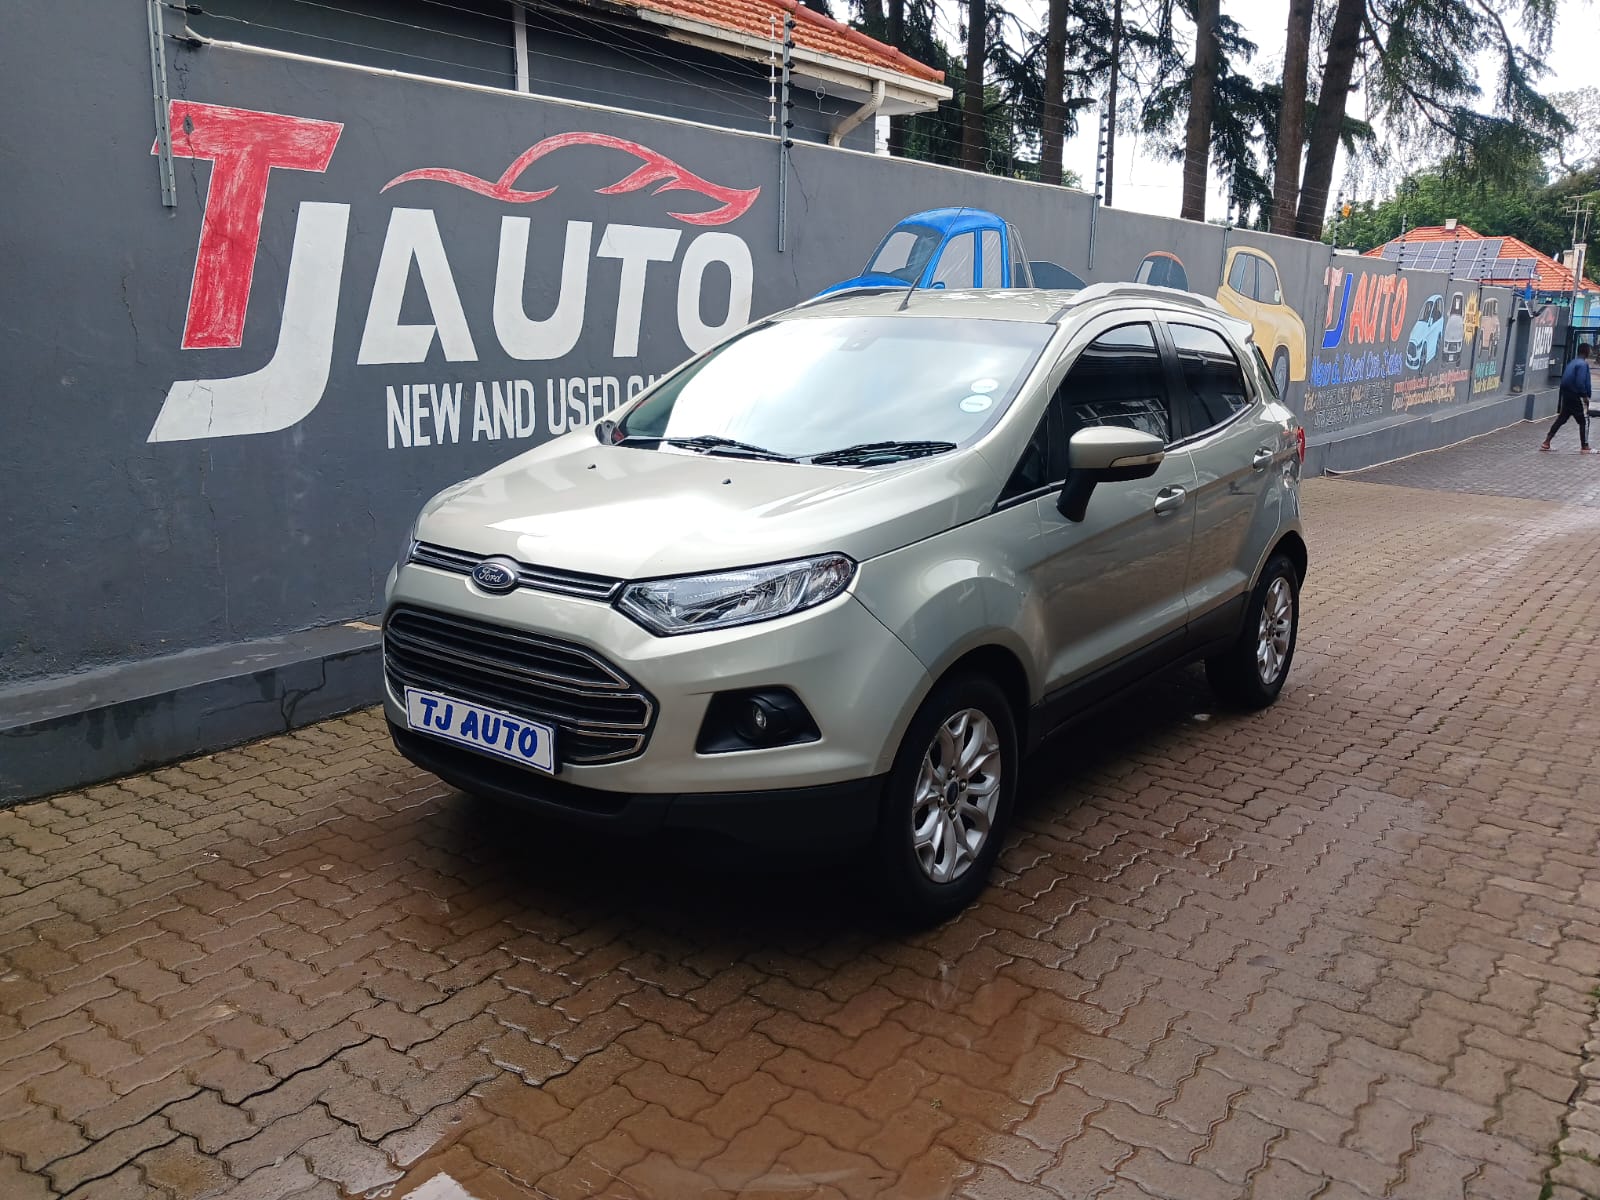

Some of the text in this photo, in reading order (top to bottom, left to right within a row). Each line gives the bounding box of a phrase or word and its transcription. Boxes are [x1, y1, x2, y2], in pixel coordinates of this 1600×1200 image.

[147, 100, 754, 443] TJ AUTO
[1321, 266, 1408, 349] TJ AUTO
[386, 383, 464, 449] NEW
[472, 379, 536, 441] AND
[547, 376, 620, 437] USED
[478, 565, 504, 584] Ford
[420, 697, 538, 758] TJ AUTO
